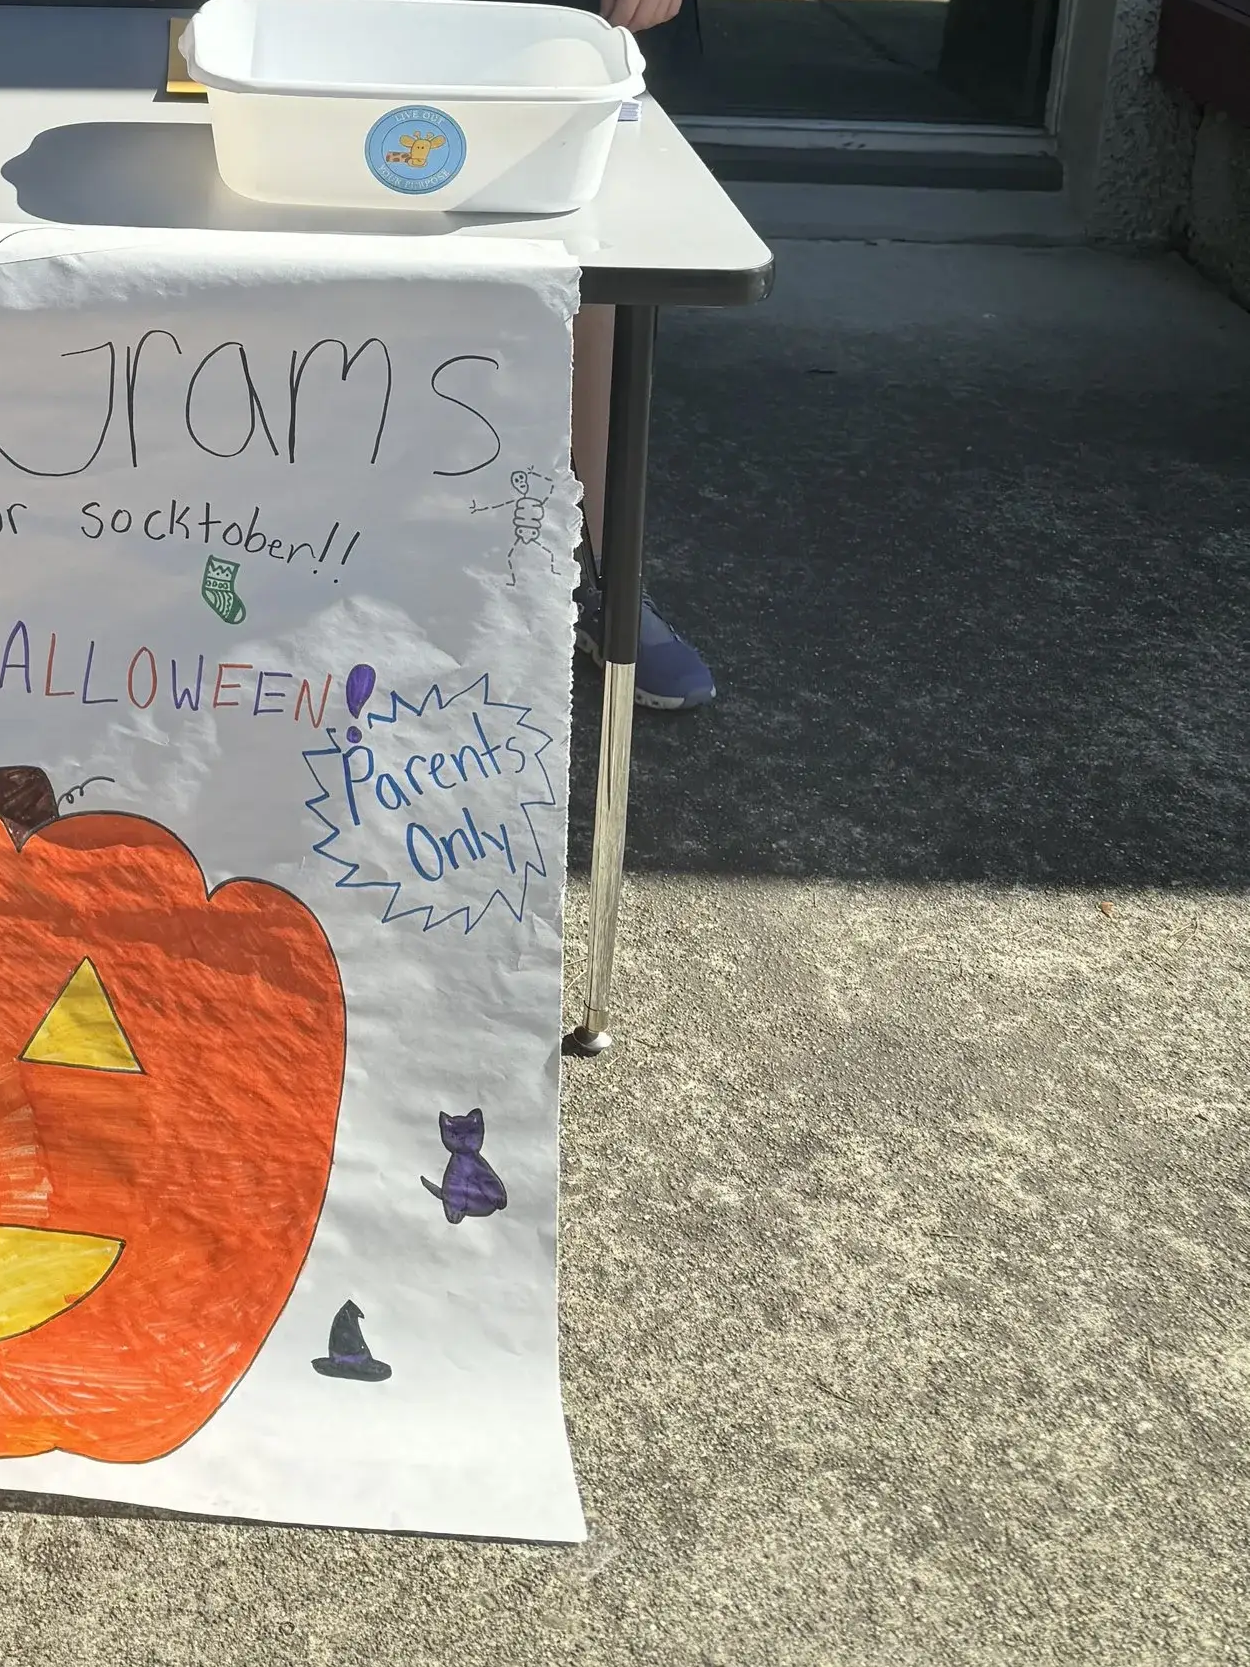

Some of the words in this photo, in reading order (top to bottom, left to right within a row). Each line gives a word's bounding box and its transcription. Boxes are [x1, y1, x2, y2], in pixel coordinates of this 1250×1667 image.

[393, 109, 420, 122] LIVE
[422, 110, 446, 125] OUT
[81, 500, 361, 584] socktober!!
[342, 712, 526, 826] Parents
[406, 807, 517, 881] Only
